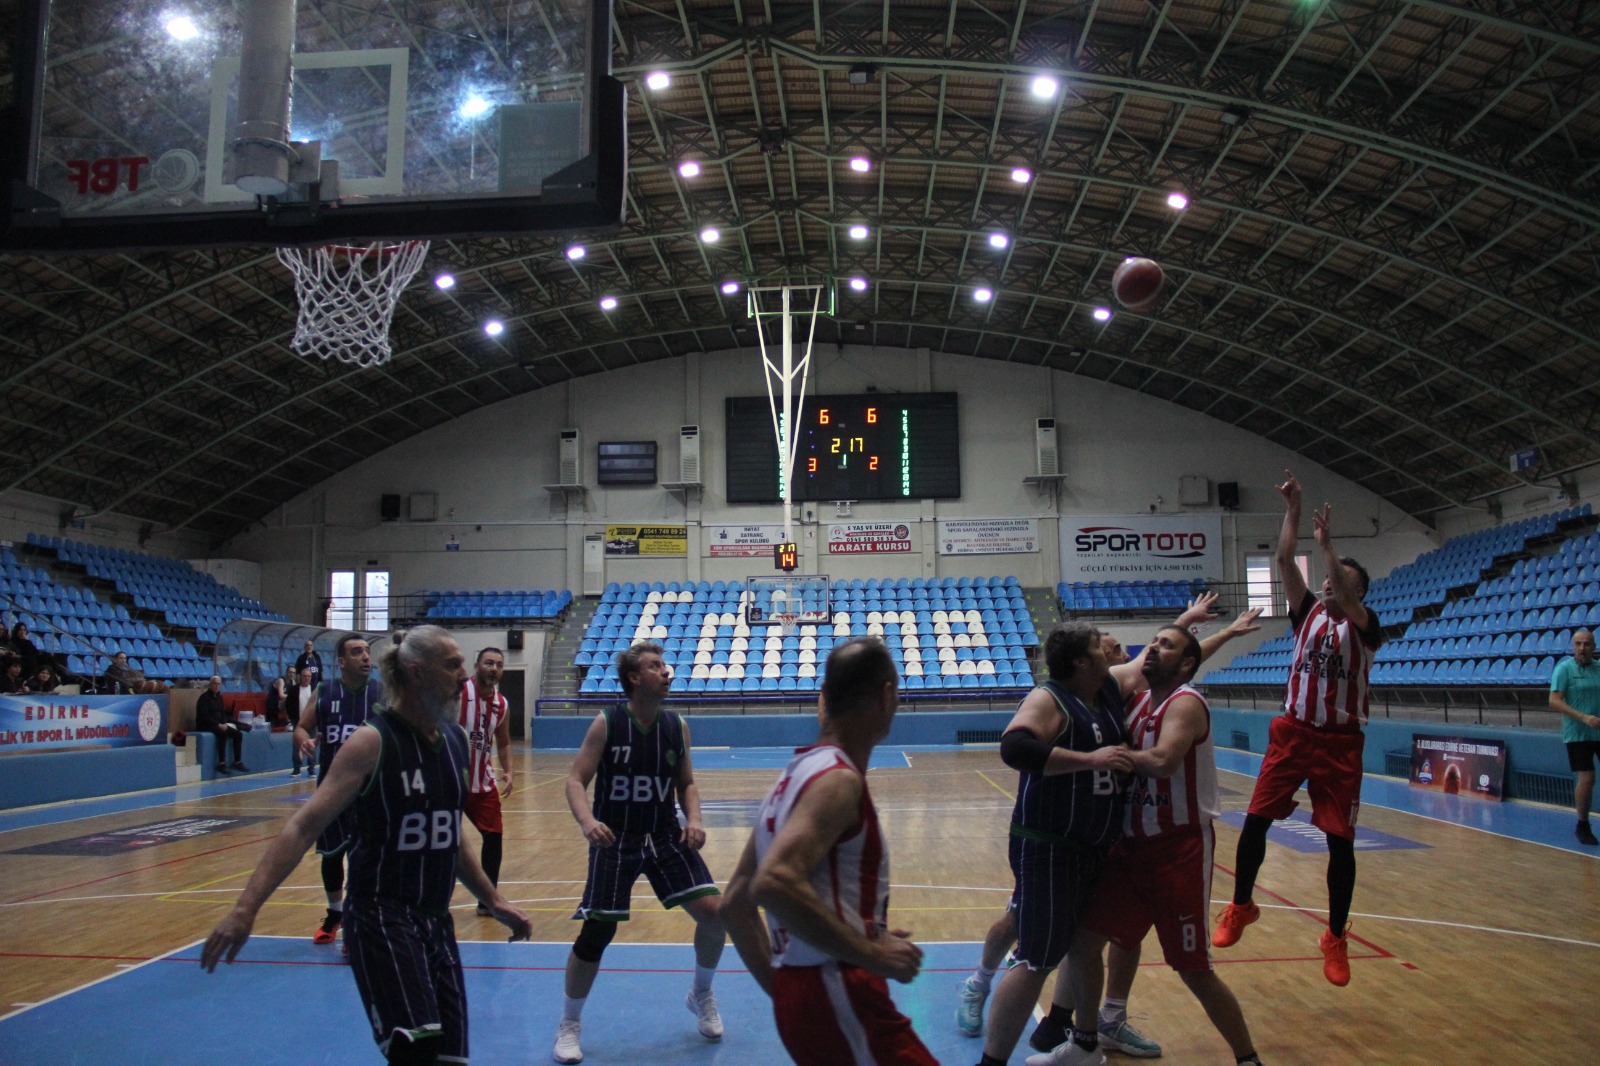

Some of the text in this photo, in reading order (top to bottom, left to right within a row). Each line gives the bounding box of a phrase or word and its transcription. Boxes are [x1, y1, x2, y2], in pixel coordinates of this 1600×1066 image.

[820, 409, 829, 424] 6
[867, 408, 877, 423] 6
[831, 437, 863, 453] 2 17
[808, 458, 817, 472] 3
[869, 456, 878, 470] 2
[779, 543, 795, 553] 2 17
[830, 542, 909, 552] KARATE KURSU
[782, 553, 794, 567] 14
[1080, 564, 1107, 573] GÜÇLÜ
[1109, 563, 1143, 572] TÜRKİYE
[1145, 563, 1162, 572] İÇİN
[1181, 562, 1203, 571] TESİS
[1308, 650, 1343, 667] FSM
[1297, 663, 1357, 680] VETERAN
[25, 703, 89, 720] EDİRNE
[20, 730, 34, 743] VE
[36, 729, 62, 742] SPOR
[65, 727, 74, 741] İL
[76, 724, 130, 740] MÜDÜRLÜĞÜ
[1091, 722, 1103, 744] 6
[611, 745, 631, 764] 77
[400, 768, 426, 797] 14
[609, 775, 672, 803] BBV
[1182, 923, 1196, 952] 8
